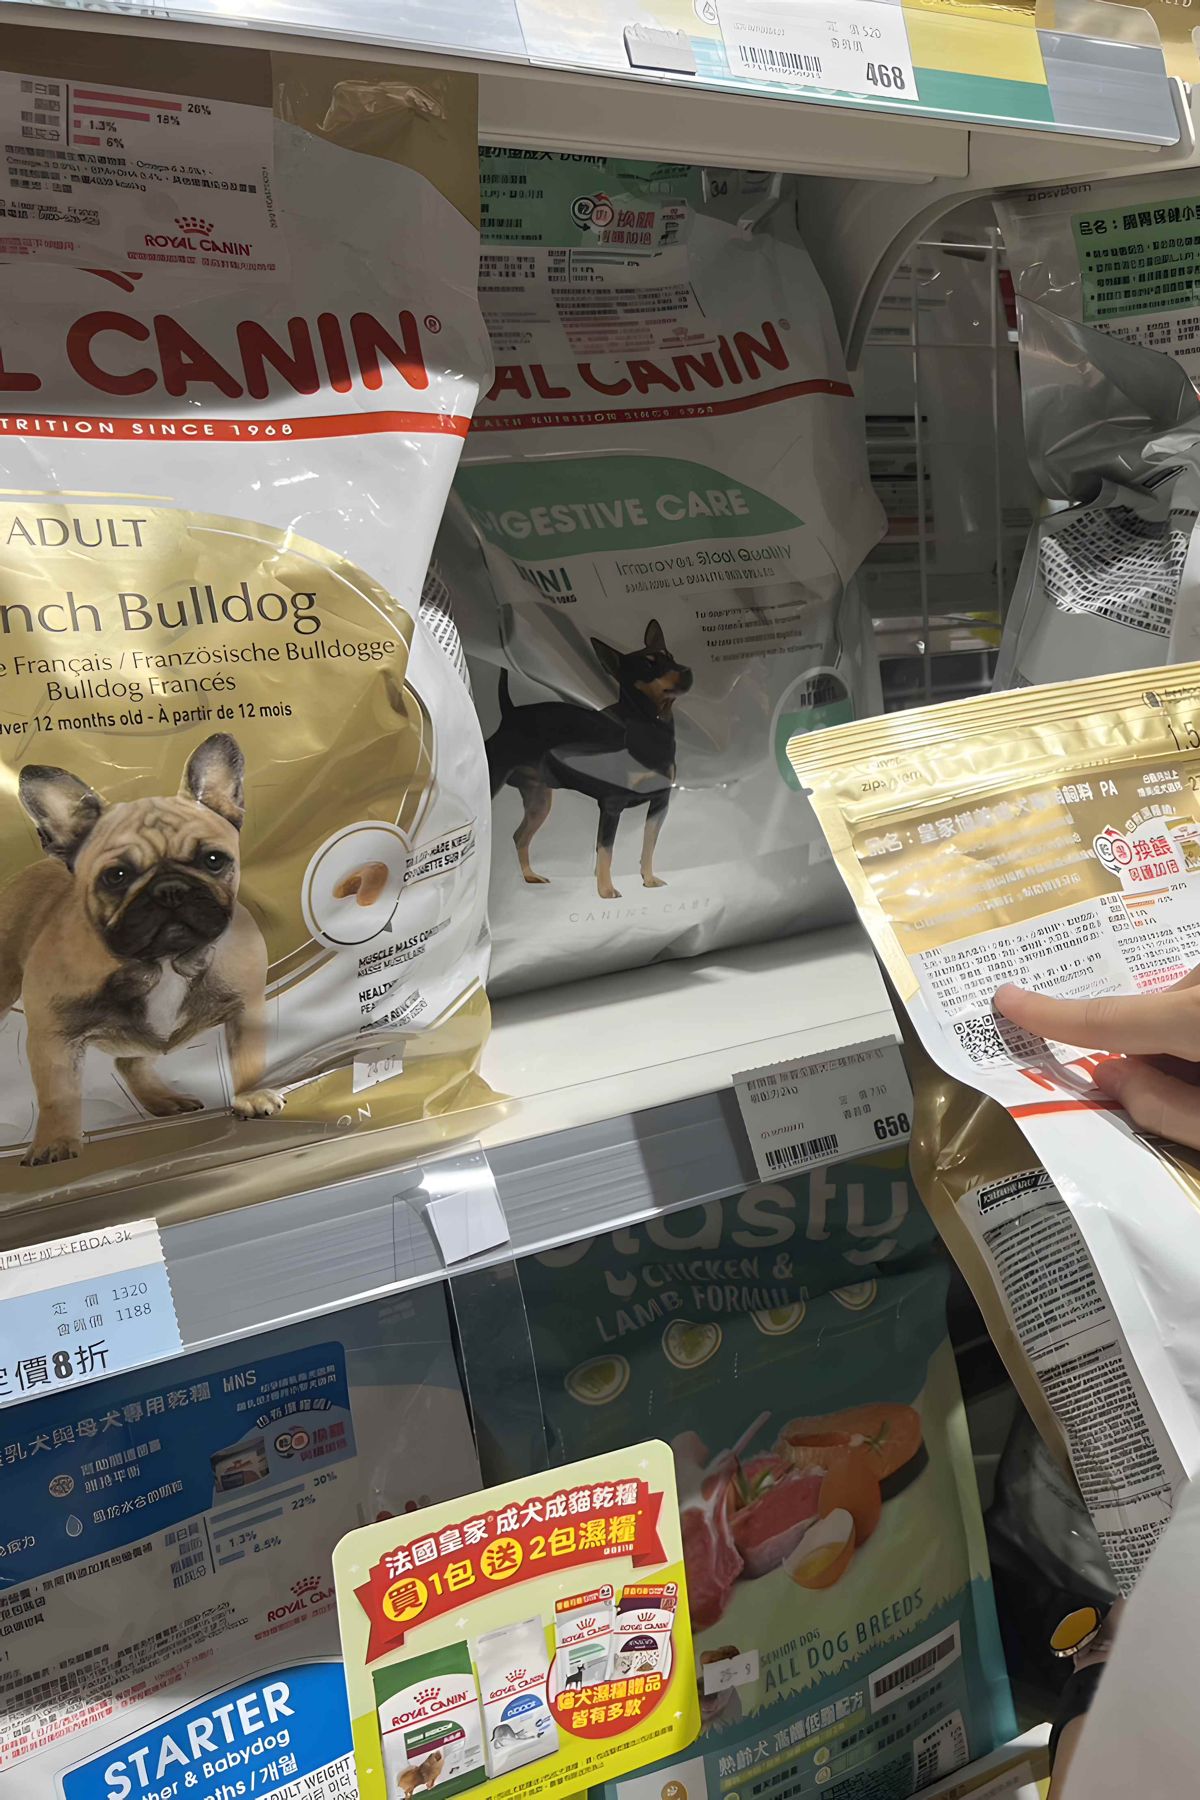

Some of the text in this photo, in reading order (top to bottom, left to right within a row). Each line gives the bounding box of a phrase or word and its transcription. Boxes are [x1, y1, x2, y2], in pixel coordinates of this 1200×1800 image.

[867, 62, 906, 91] 468
[144, 234, 251, 257] ROYAL CANIN
[66, 309, 430, 400] CANIN
[131, 422, 215, 436] SINCE
[228, 423, 294, 436] 1968
[656, 488, 750, 522] CARE
[6, 516, 148, 549] ADULT
[118, 581, 322, 636] Bulldog
[15, 655, 113, 677] Français
[132, 641, 281, 671] Französische
[285, 638, 396, 662] Bulldogge
[47, 671, 237, 703] Bulldog Francés
[34, 715, 52, 733] 12
[58, 711, 117, 731] months
[119, 709, 143, 728] old
[158, 702, 170, 724] À
[173, 704, 212, 726] partir
[217, 703, 234, 722] de
[239, 702, 256, 720] 12
[260, 701, 293, 718] mois
[1167, 719, 1200, 752] 1.5
[1100, 779, 1118, 798] PA
[873, 1112, 911, 1140] 658
[641, 1252, 794, 1288] CHICKEN &
[112, 1281, 148, 1302] 1320
[116, 1302, 153, 1323] 1188
[595, 1286, 684, 1343] LAMB
[384, 1518, 489, 1580] 法國皇家
[266, 1600, 308, 1623] ROYAL
[764, 1587, 925, 1693] ALL DOG BREEDS
[391, 1690, 468, 1727] ROYAL CANIN
[103, 1680, 296, 1800] STARTER
[184, 1770, 199, 1789] &
[202, 1728, 291, 1779] Babydog
[302, 1756, 351, 1789] WEIGHT
